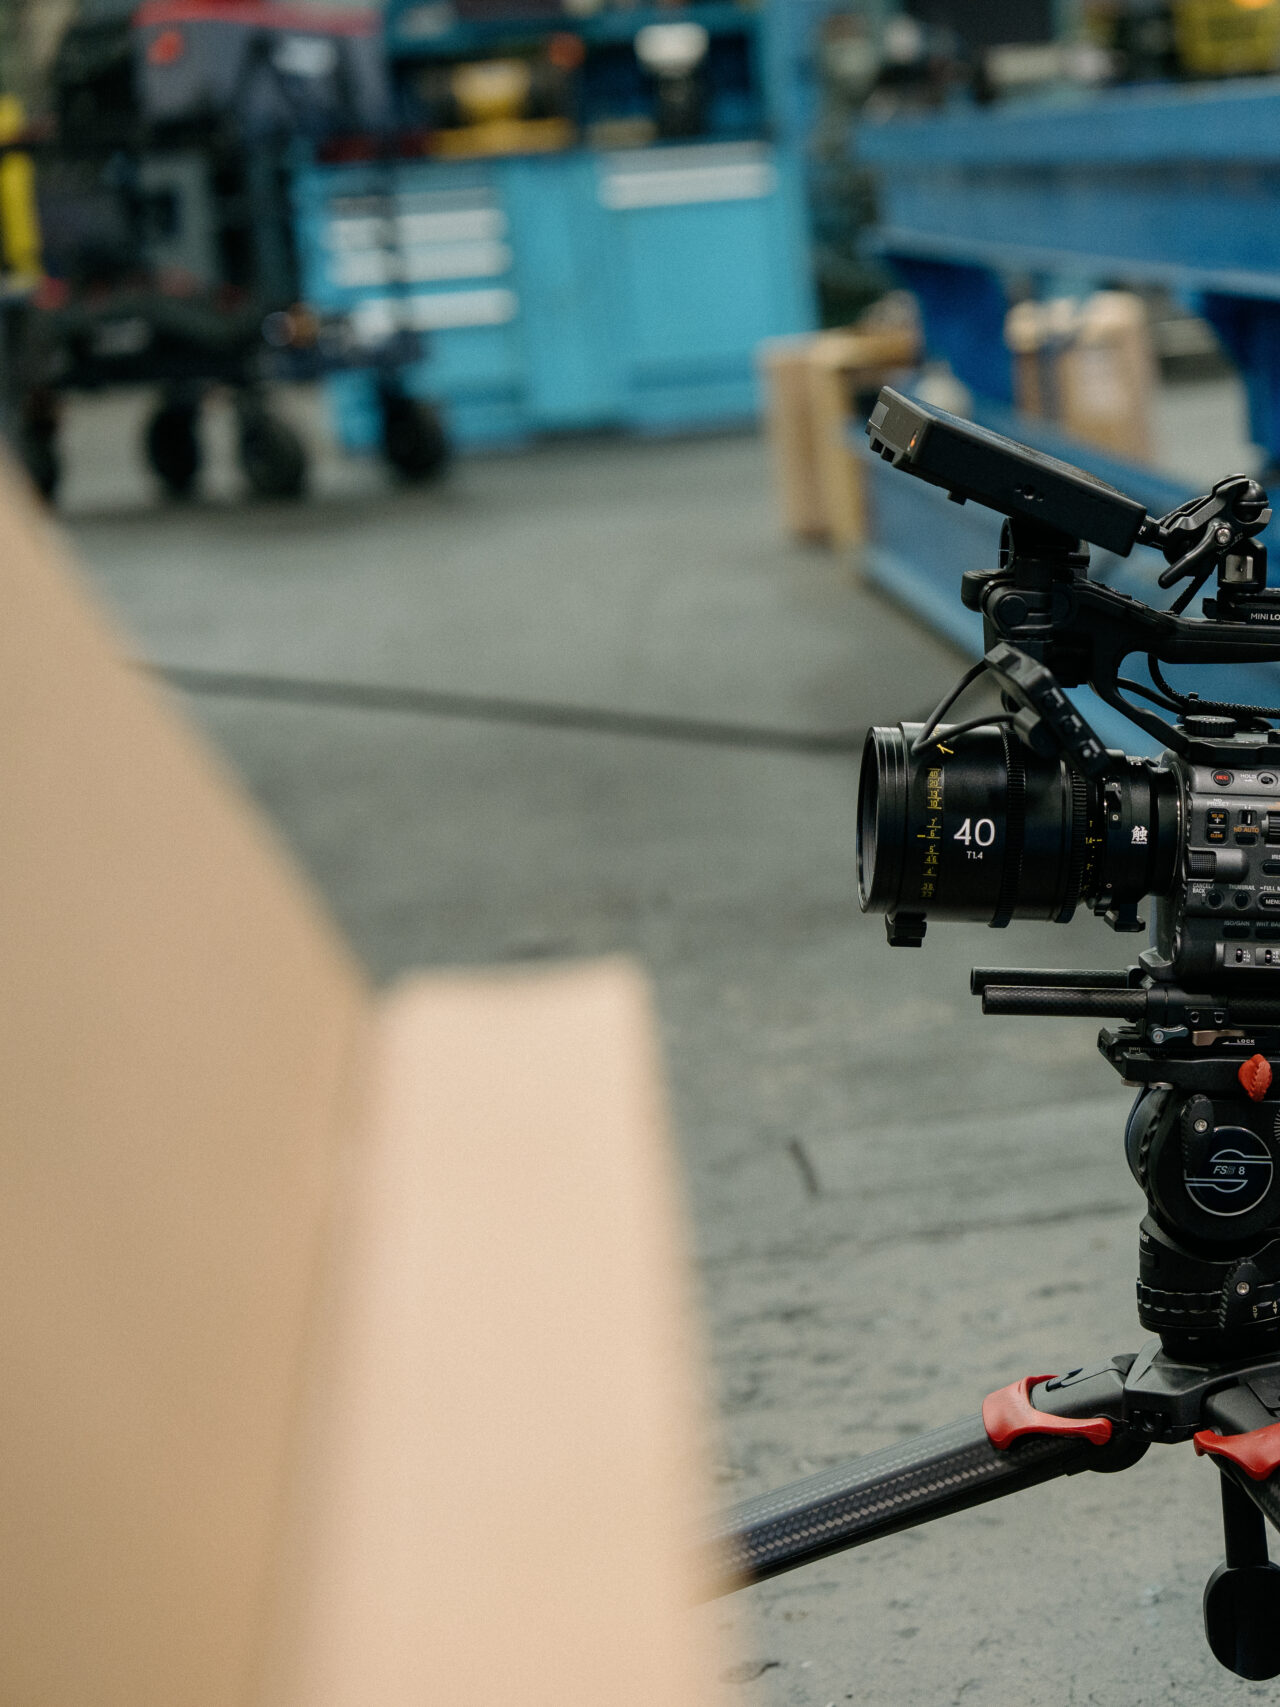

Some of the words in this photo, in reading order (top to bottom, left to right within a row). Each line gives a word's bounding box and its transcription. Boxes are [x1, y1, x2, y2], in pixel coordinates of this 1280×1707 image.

[1250, 612, 1269, 620] MINI
[953, 818, 996, 847] 40
[966, 850, 983, 859] T1.4
[1238, 1166, 1246, 1175] 8
[1252, 1305, 1258, 1313] 5
